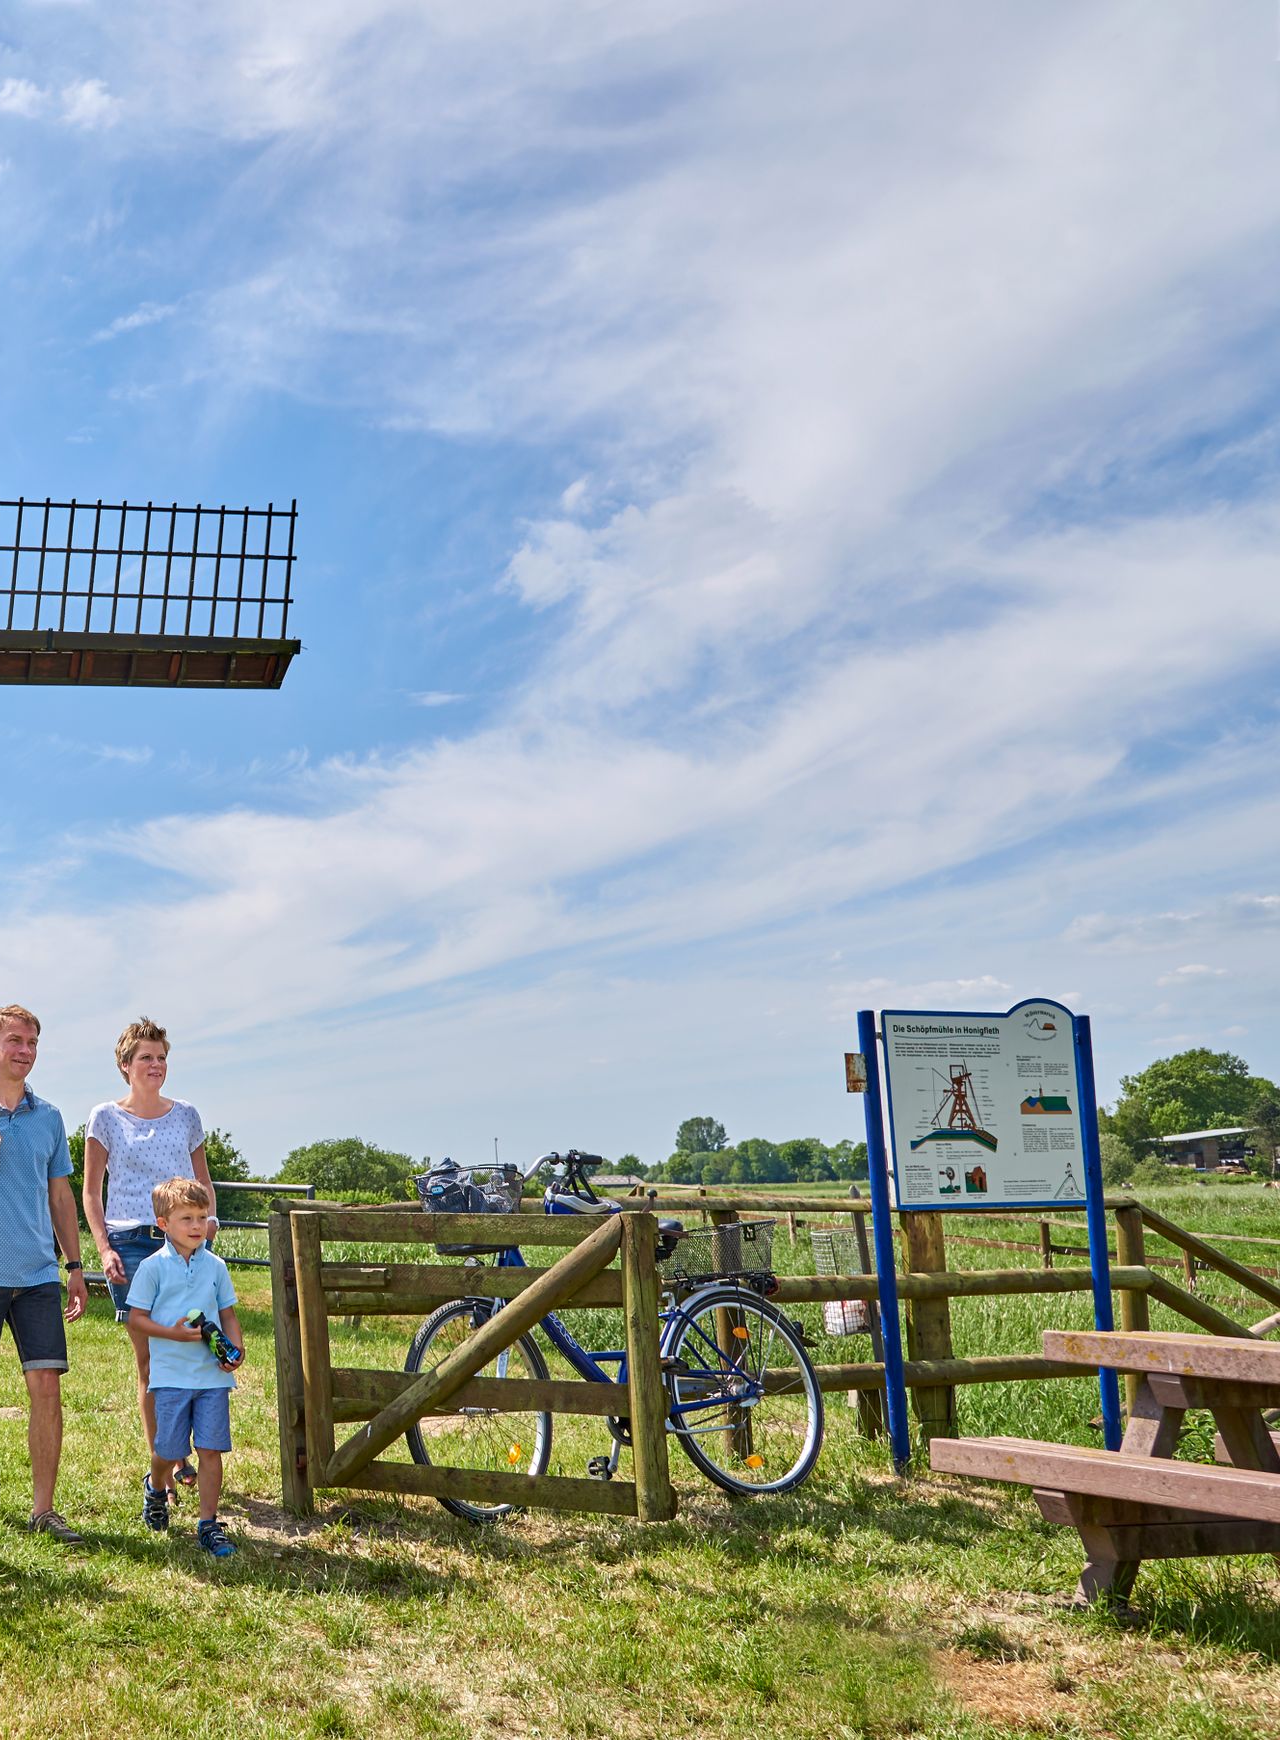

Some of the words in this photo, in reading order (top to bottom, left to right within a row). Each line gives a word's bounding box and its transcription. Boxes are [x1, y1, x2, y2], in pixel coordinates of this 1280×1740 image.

[893, 1025, 905, 1033] Die
[906, 1025, 954, 1035] Schöpfmühle
[955, 1026, 962, 1034] in
[963, 1026, 1000, 1037] Honigfleth
